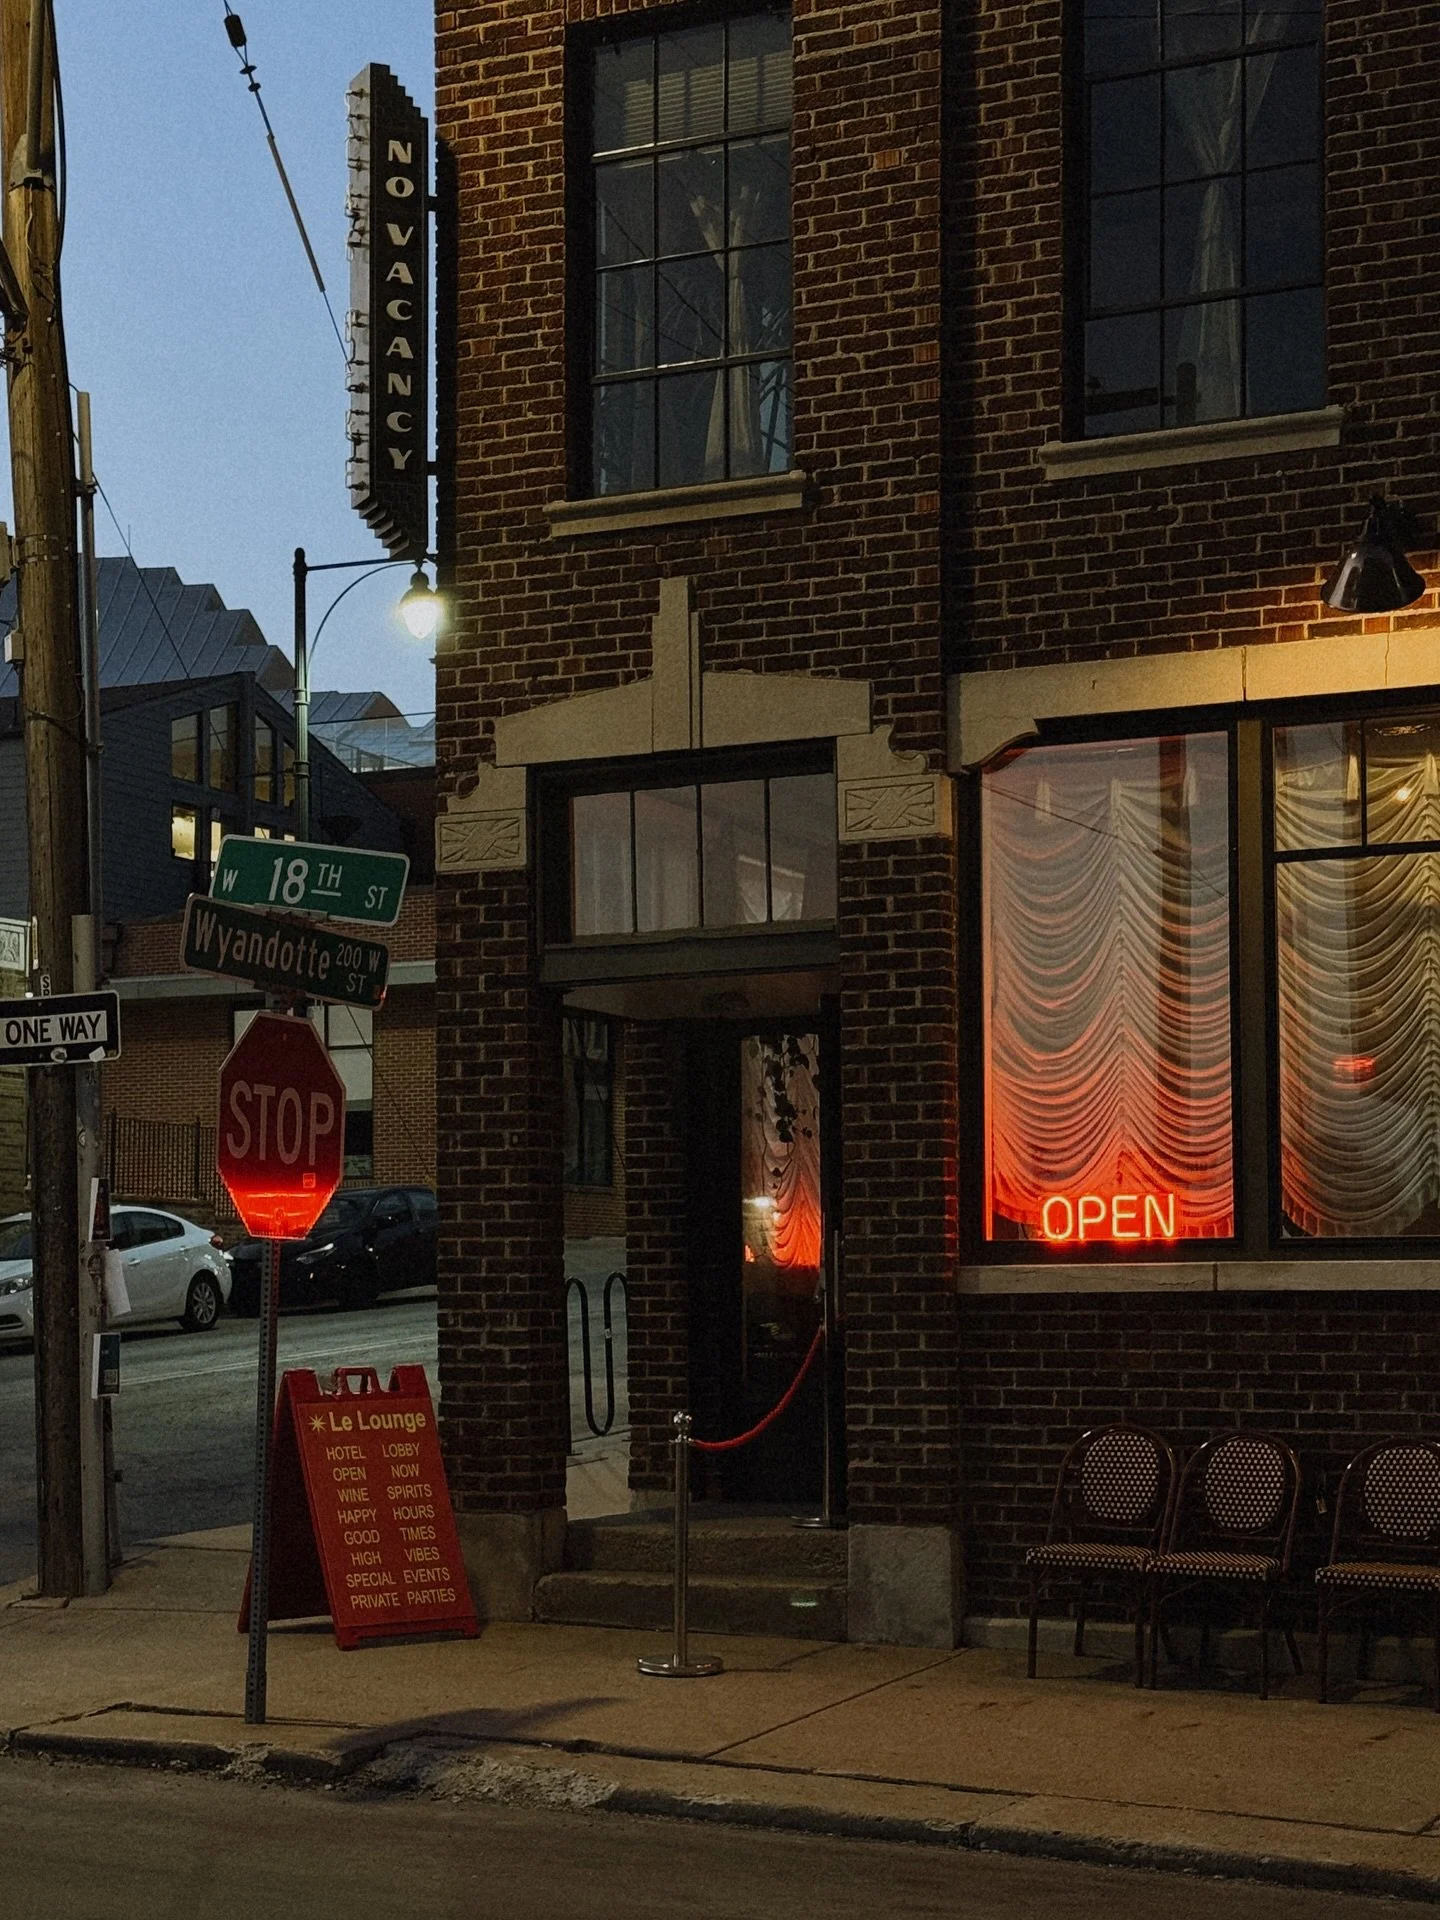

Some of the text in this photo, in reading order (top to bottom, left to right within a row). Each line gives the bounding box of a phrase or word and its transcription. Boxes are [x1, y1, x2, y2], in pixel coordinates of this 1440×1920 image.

[386, 139, 415, 470] NO VACANCY
[222, 856, 389, 911] W 18TH ST
[195, 908, 381, 981] Wyandotte 200 W
[346, 972, 367, 994] ST
[5, 1013, 102, 1046] ONE WAY
[226, 1079, 335, 1167] STOP
[1042, 1193, 1175, 1240] OPEN
[328, 1410, 426, 1433] Le Lounge
[326, 1442, 420, 1461] HOTEL LOBBY
[332, 1463, 420, 1482] OPEN NOW
[336, 1483, 433, 1503] WINE SPIRITS
[337, 1504, 436, 1525] HAPPY HOURS
[343, 1525, 436, 1546] GOOD TIMES
[351, 1546, 440, 1567] HIGH VIBES
[345, 1567, 450, 1589] SPECIAL EVENTS
[350, 1587, 456, 1610] PRIVATE PARTIES
